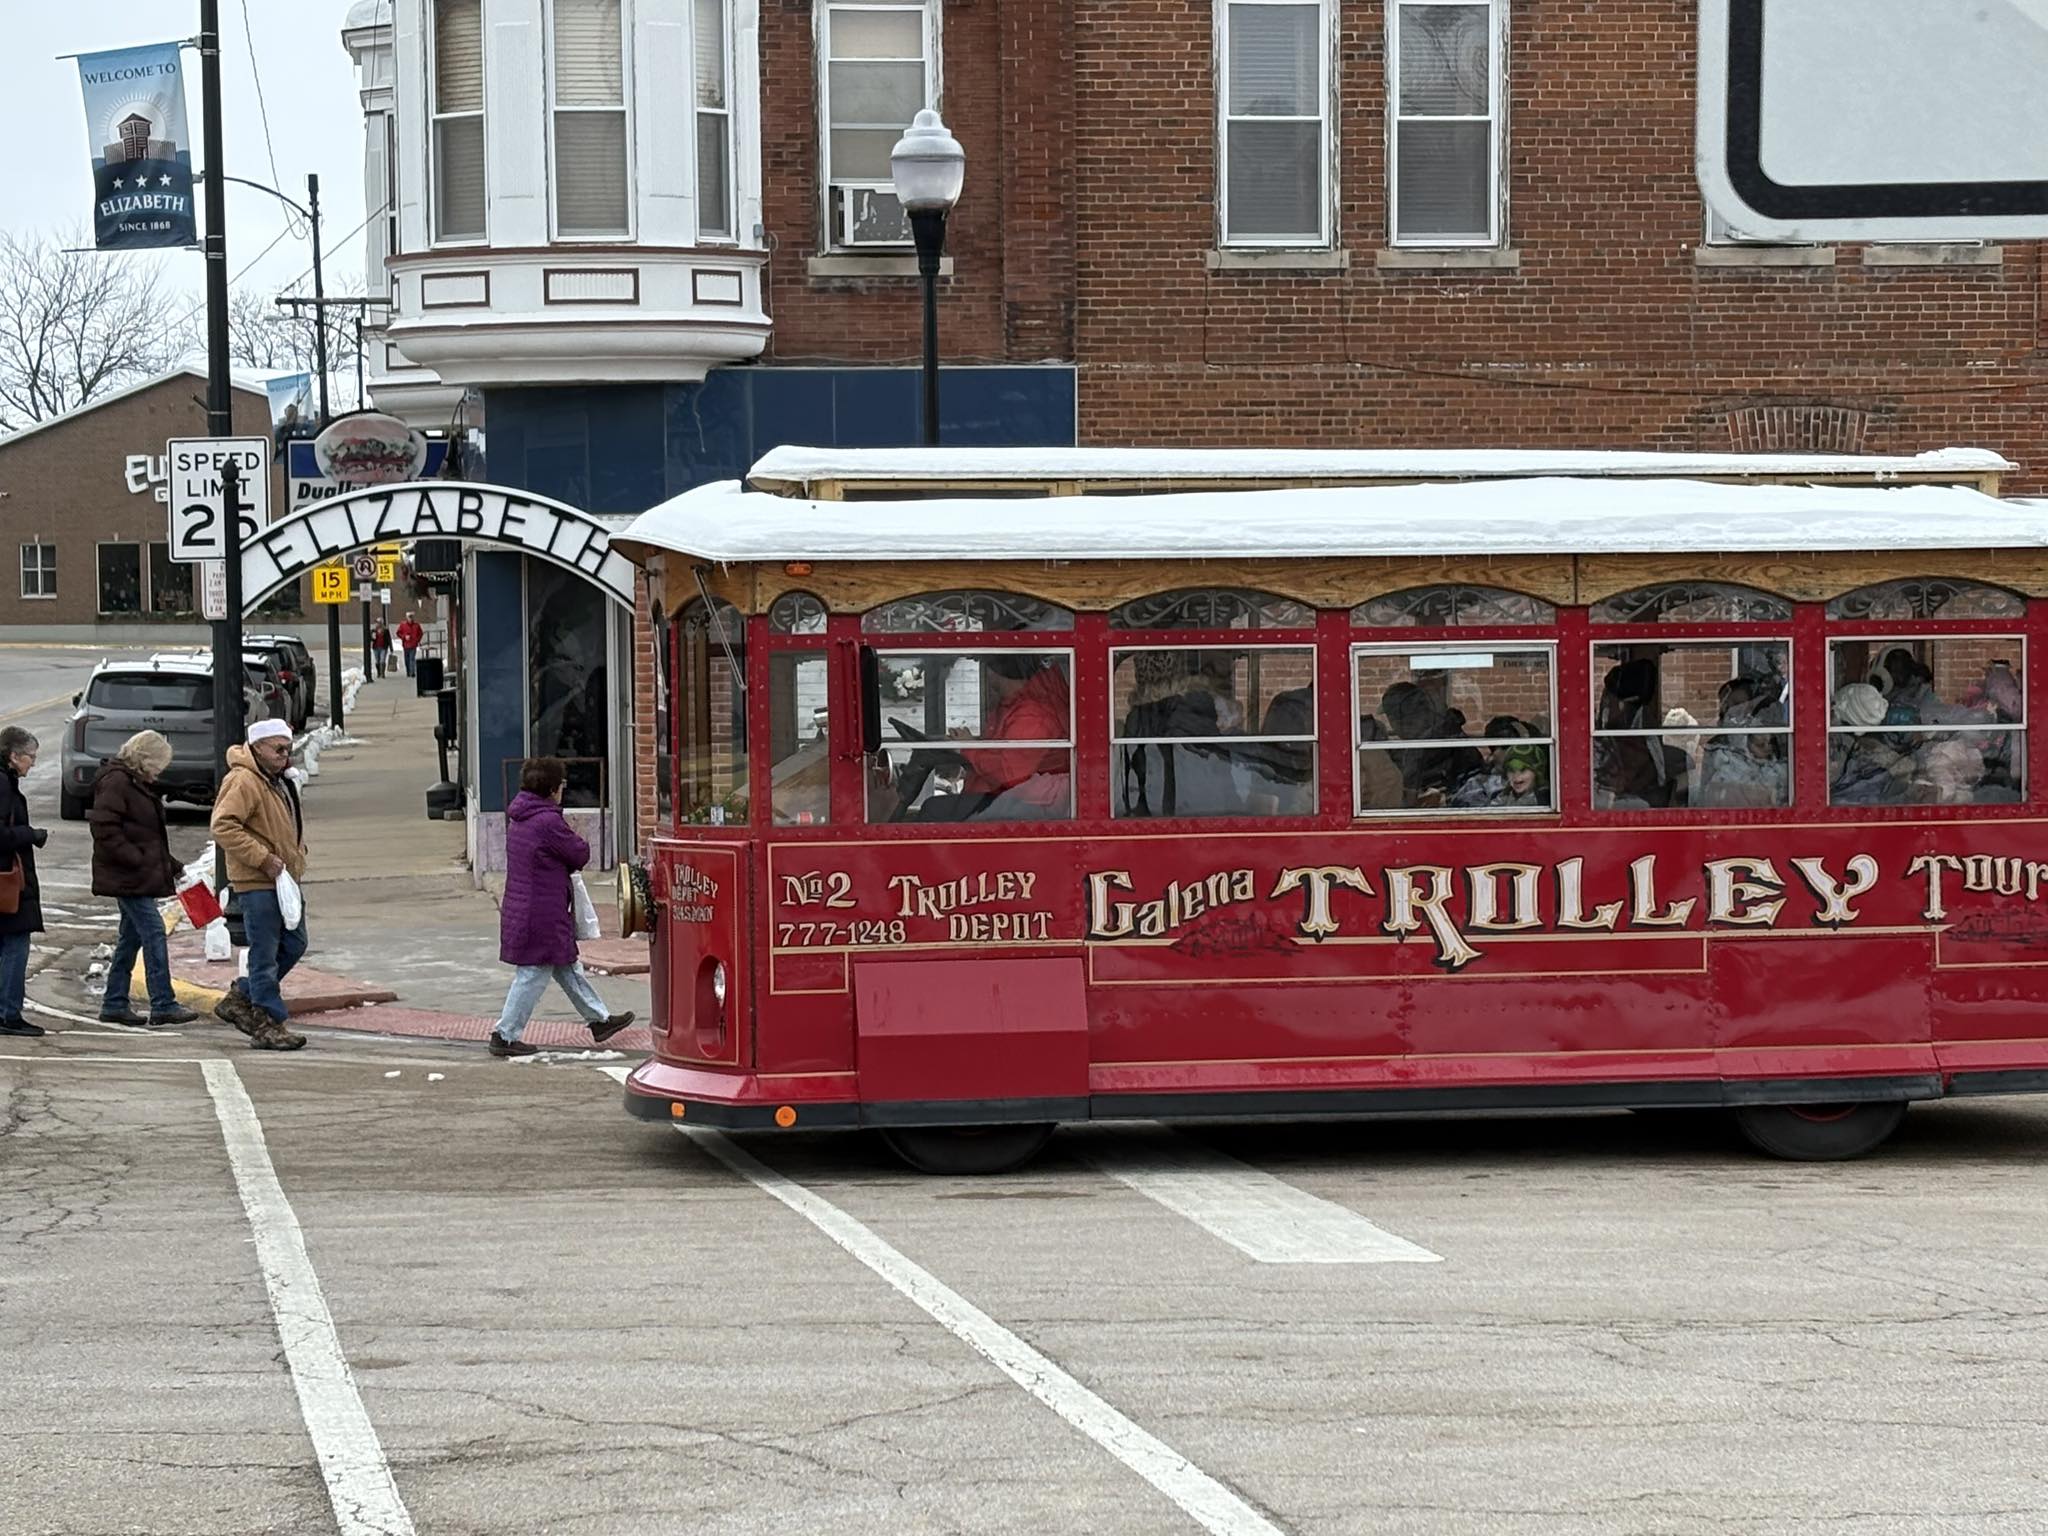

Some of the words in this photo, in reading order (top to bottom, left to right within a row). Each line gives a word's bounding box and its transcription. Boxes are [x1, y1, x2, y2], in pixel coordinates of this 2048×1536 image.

[85, 65, 153, 85] WELCOME
[156, 62, 176, 74] TO
[100, 194, 185, 216] ELIZABETH
[119, 222, 147, 232] SINCE
[150, 221, 171, 231] 1868
[177, 452, 260, 472] SPEED
[187, 478, 251, 497] LIMT
[265, 489, 613, 578] ELIZABETH
[321, 571, 340, 588] 15
[380, 565, 390, 575] 15
[320, 591, 342, 599] MPH
[673, 863, 719, 899] TROLLEY
[826, 872, 857, 908] 2
[1088, 869, 1254, 937] Galena
[778, 919, 906, 946] 777-1248
[949, 911, 1053, 941] DEPOT
